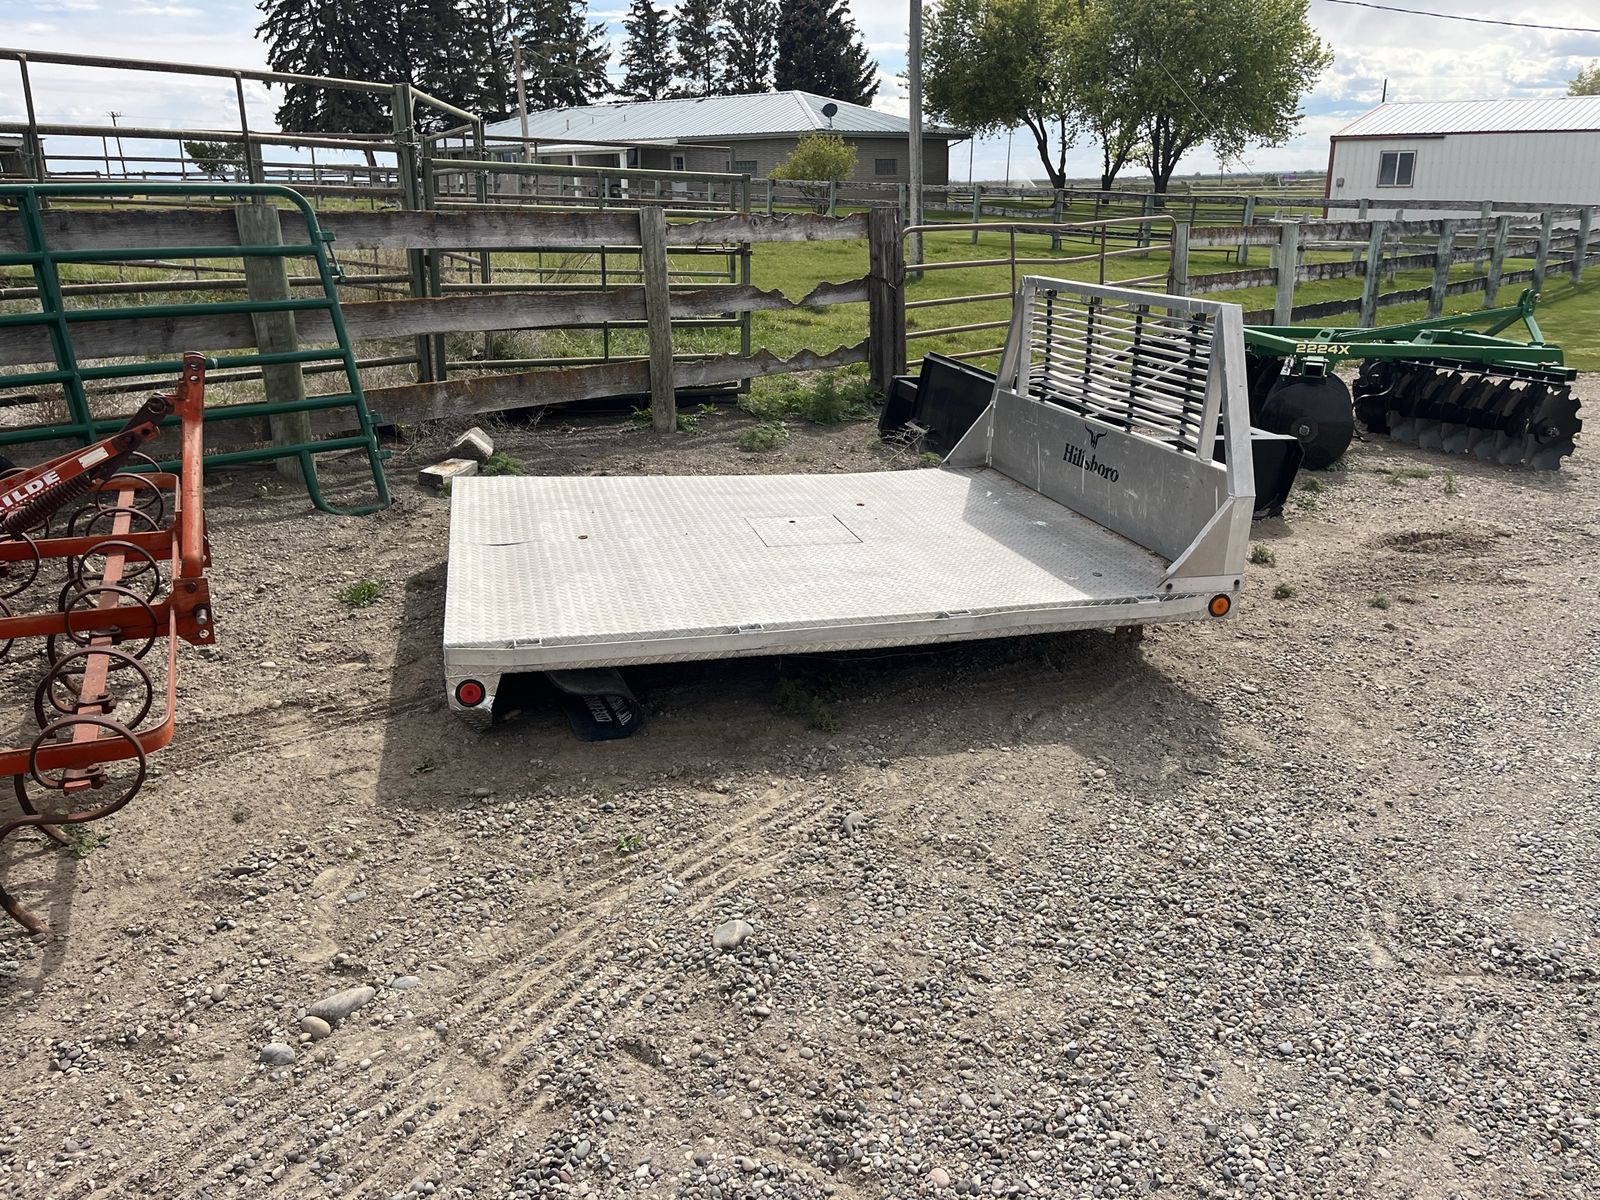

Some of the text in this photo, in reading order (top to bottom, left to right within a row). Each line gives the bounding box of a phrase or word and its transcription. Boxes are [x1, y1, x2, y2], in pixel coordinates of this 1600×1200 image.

[1295, 343, 1351, 355] 2224X
[1062, 442, 1119, 483] Hillsboro
[0, 470, 61, 511] ILDE
